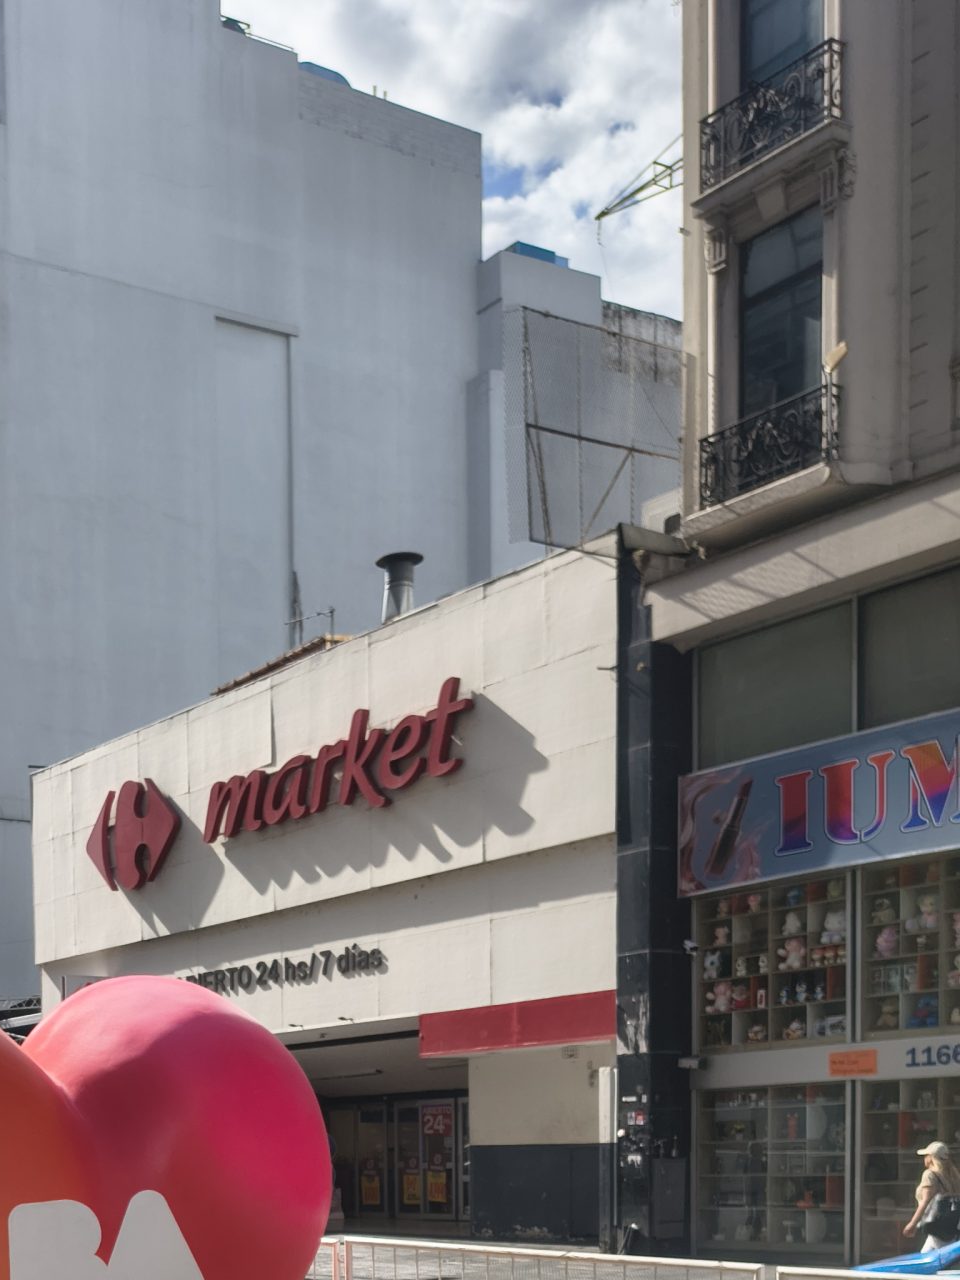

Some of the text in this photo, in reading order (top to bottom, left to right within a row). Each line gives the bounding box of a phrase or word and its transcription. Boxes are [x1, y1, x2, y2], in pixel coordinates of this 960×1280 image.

[203, 677, 475, 843] market
[255, 958, 280, 986] 24
[337, 943, 383, 975] días
[423, 1115, 445, 1134] 24
